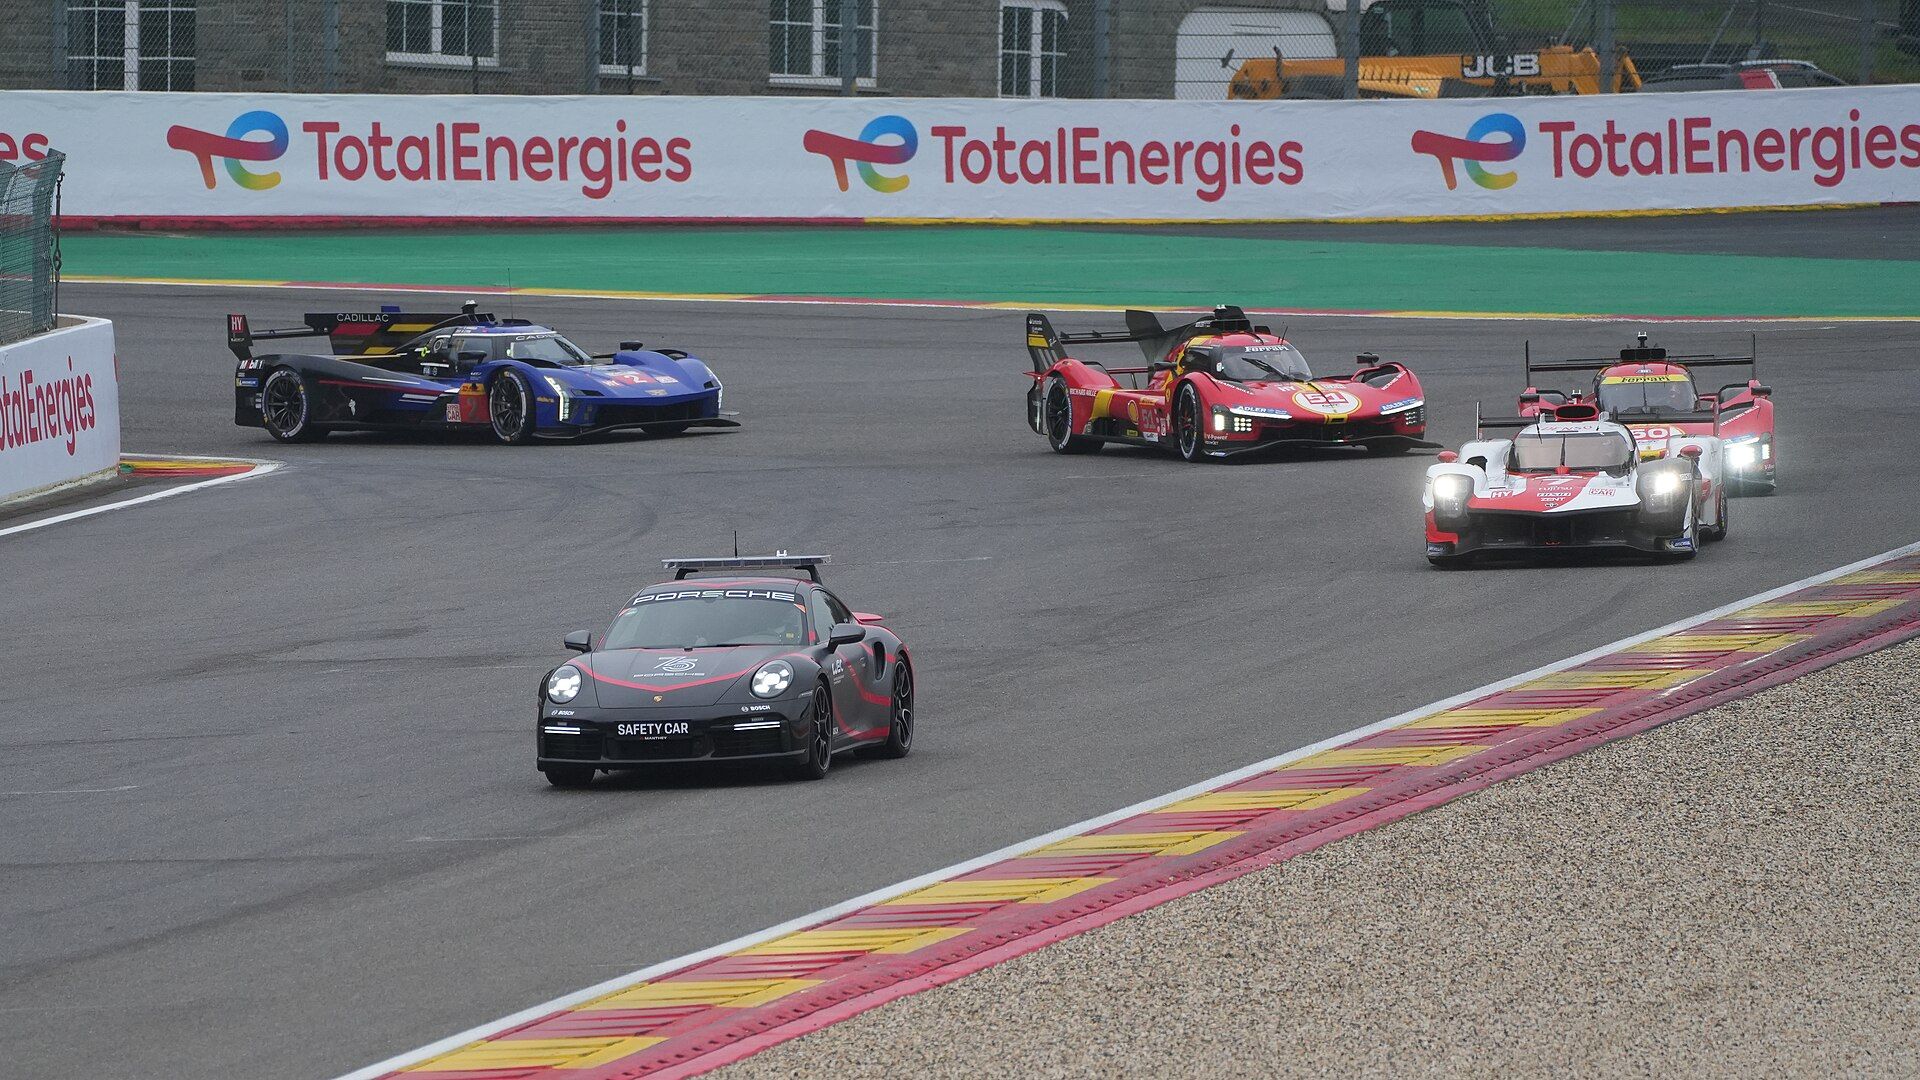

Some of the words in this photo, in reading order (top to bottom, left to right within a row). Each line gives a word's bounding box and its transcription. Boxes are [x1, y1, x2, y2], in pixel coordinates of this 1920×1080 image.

[302, 119, 692, 199] TotalEnergies
[931, 124, 1304, 202] TotalEnergies
[231, 316, 242, 331] HY
[336, 313, 389, 322] CADILLAC
[1244, 345, 1290, 353] Ferrari
[623, 375, 647, 384] 2
[1304, 392, 1348, 404] 51
[467, 398, 478, 417] 2
[1238, 405, 1267, 413] ADLER
[1630, 428, 1669, 439] 50
[1491, 490, 1512, 498] HY
[632, 590, 795, 605] PORSCHE
[617, 723, 662, 735] SAFETY
[664, 723, 689, 734] CAR
